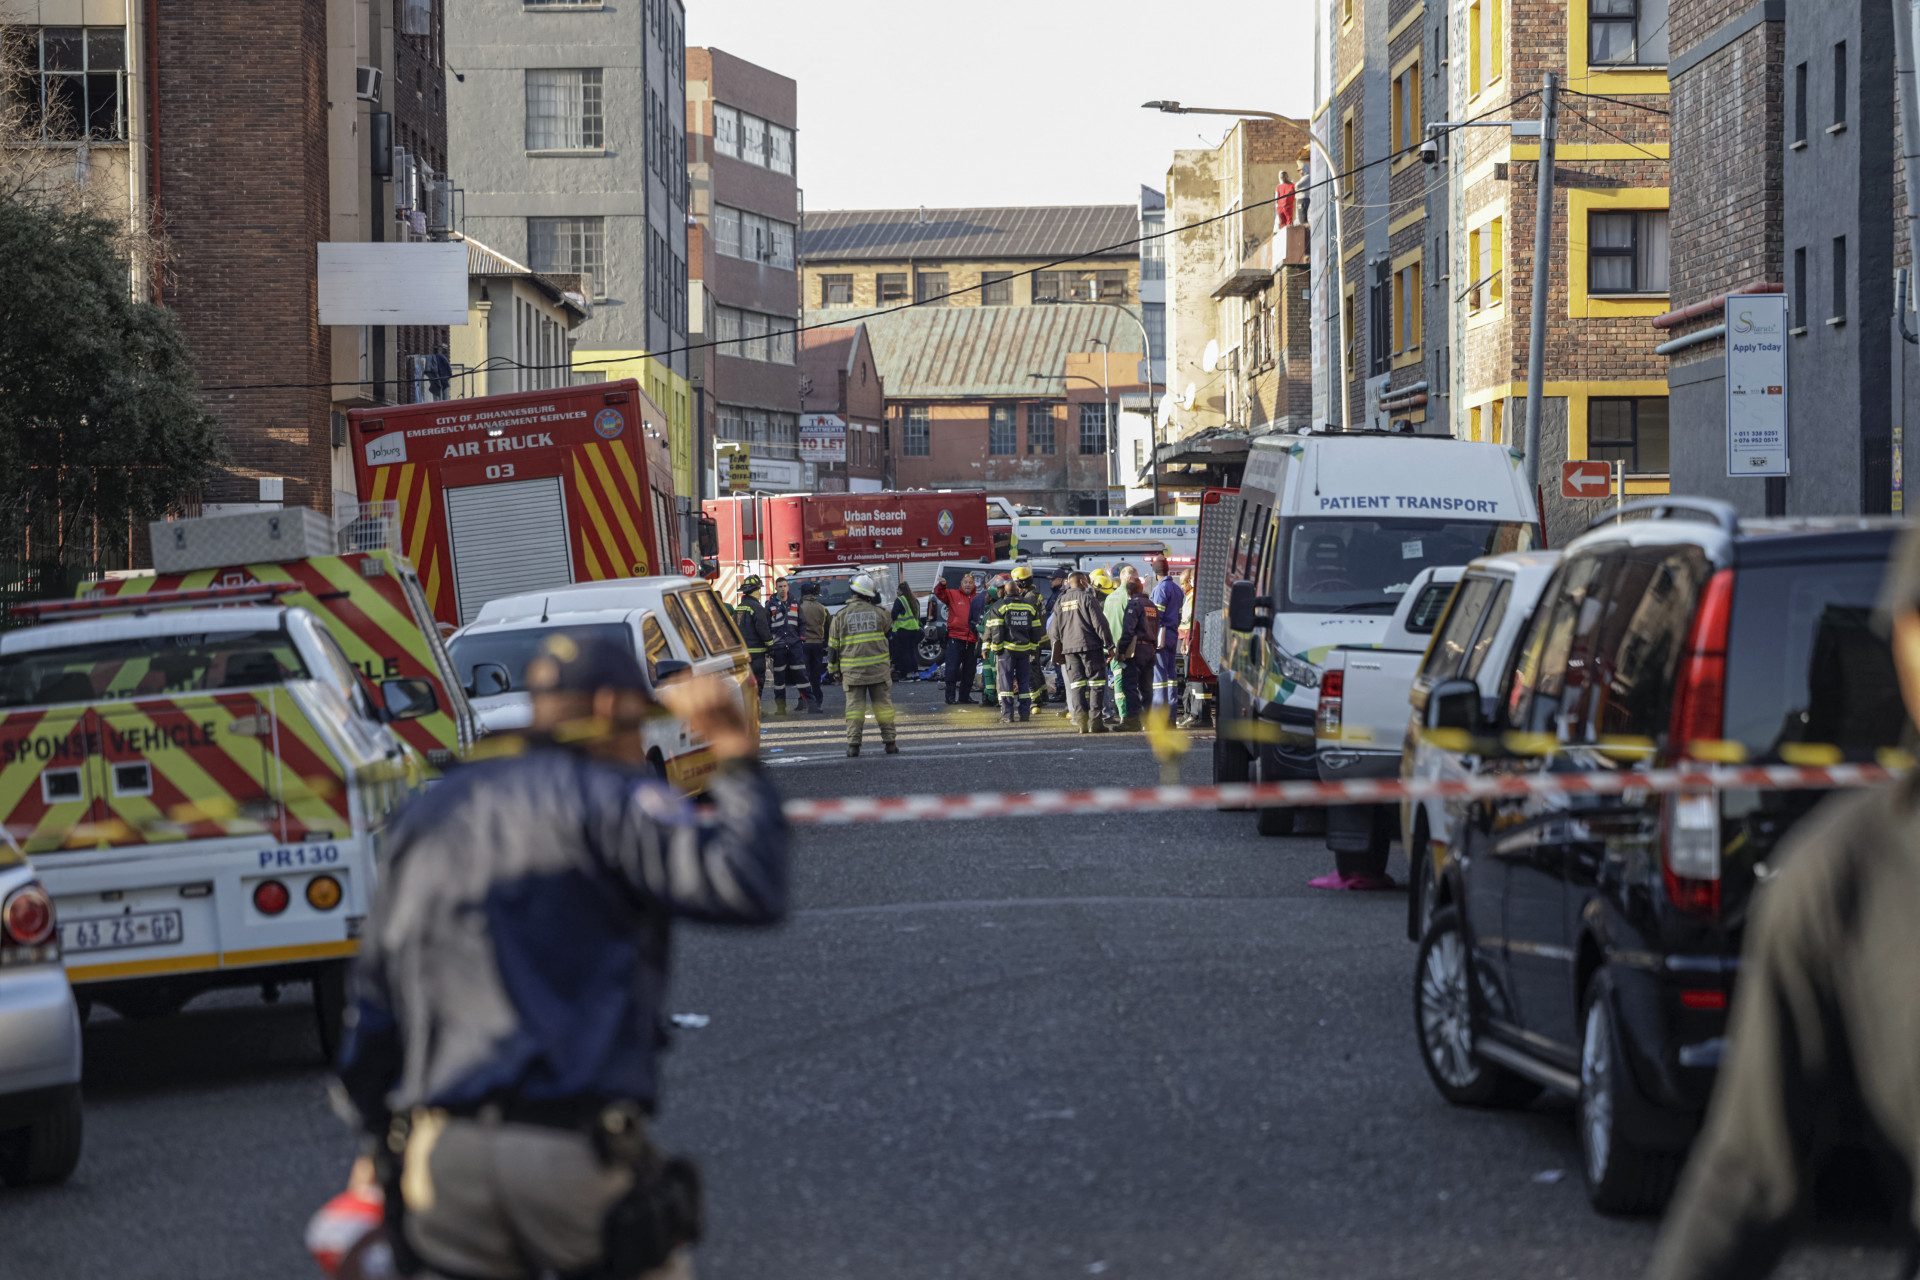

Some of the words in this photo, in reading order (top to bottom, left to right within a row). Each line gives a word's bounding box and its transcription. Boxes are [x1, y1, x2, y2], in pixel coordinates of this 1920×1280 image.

[1733, 343, 1757, 353] Apply
[1757, 342, 1782, 353] Today
[436, 416, 457, 425] CITY
[459, 414, 473, 423] OF
[474, 404, 556, 421] JOHANNESBURG
[406, 424, 465, 438] EMERGENCY
[467, 415, 539, 431] MANAGEMENT
[540, 410, 588, 423] SERVICES
[443, 441, 480, 459] AIR
[484, 432, 554, 453] TRUCK
[800, 438, 818, 449] TO
[821, 438, 845, 449] LET
[372, 444, 401, 460] Joburg
[485, 463, 515, 479] 03
[1319, 495, 1391, 510] PATIENT
[1395, 496, 1499, 514] TRANSPORT
[843, 510, 872, 522] Urban
[873, 509, 907, 521] Search
[848, 525, 867, 537] And
[868, 525, 903, 537] Rescue
[1049, 527, 1092, 535] GAUTENG
[1093, 527, 1148, 535] EMERGENCY
[1150, 526, 1188, 535] MEDICAL
[837, 554, 847, 562] City
[853, 553, 885, 561] Johannesburg
[885, 552, 910, 560] Emergency
[634, 564, 646, 575] 80
[682, 565, 695, 575] TOP
[848, 621, 876, 633] EMS
[110, 721, 216, 754] VEHICLE
[259, 845, 339, 869] PR130
[77, 922, 101, 948] 63
[112, 918, 135, 945] ZS
[151, 913, 176, 942] GP
